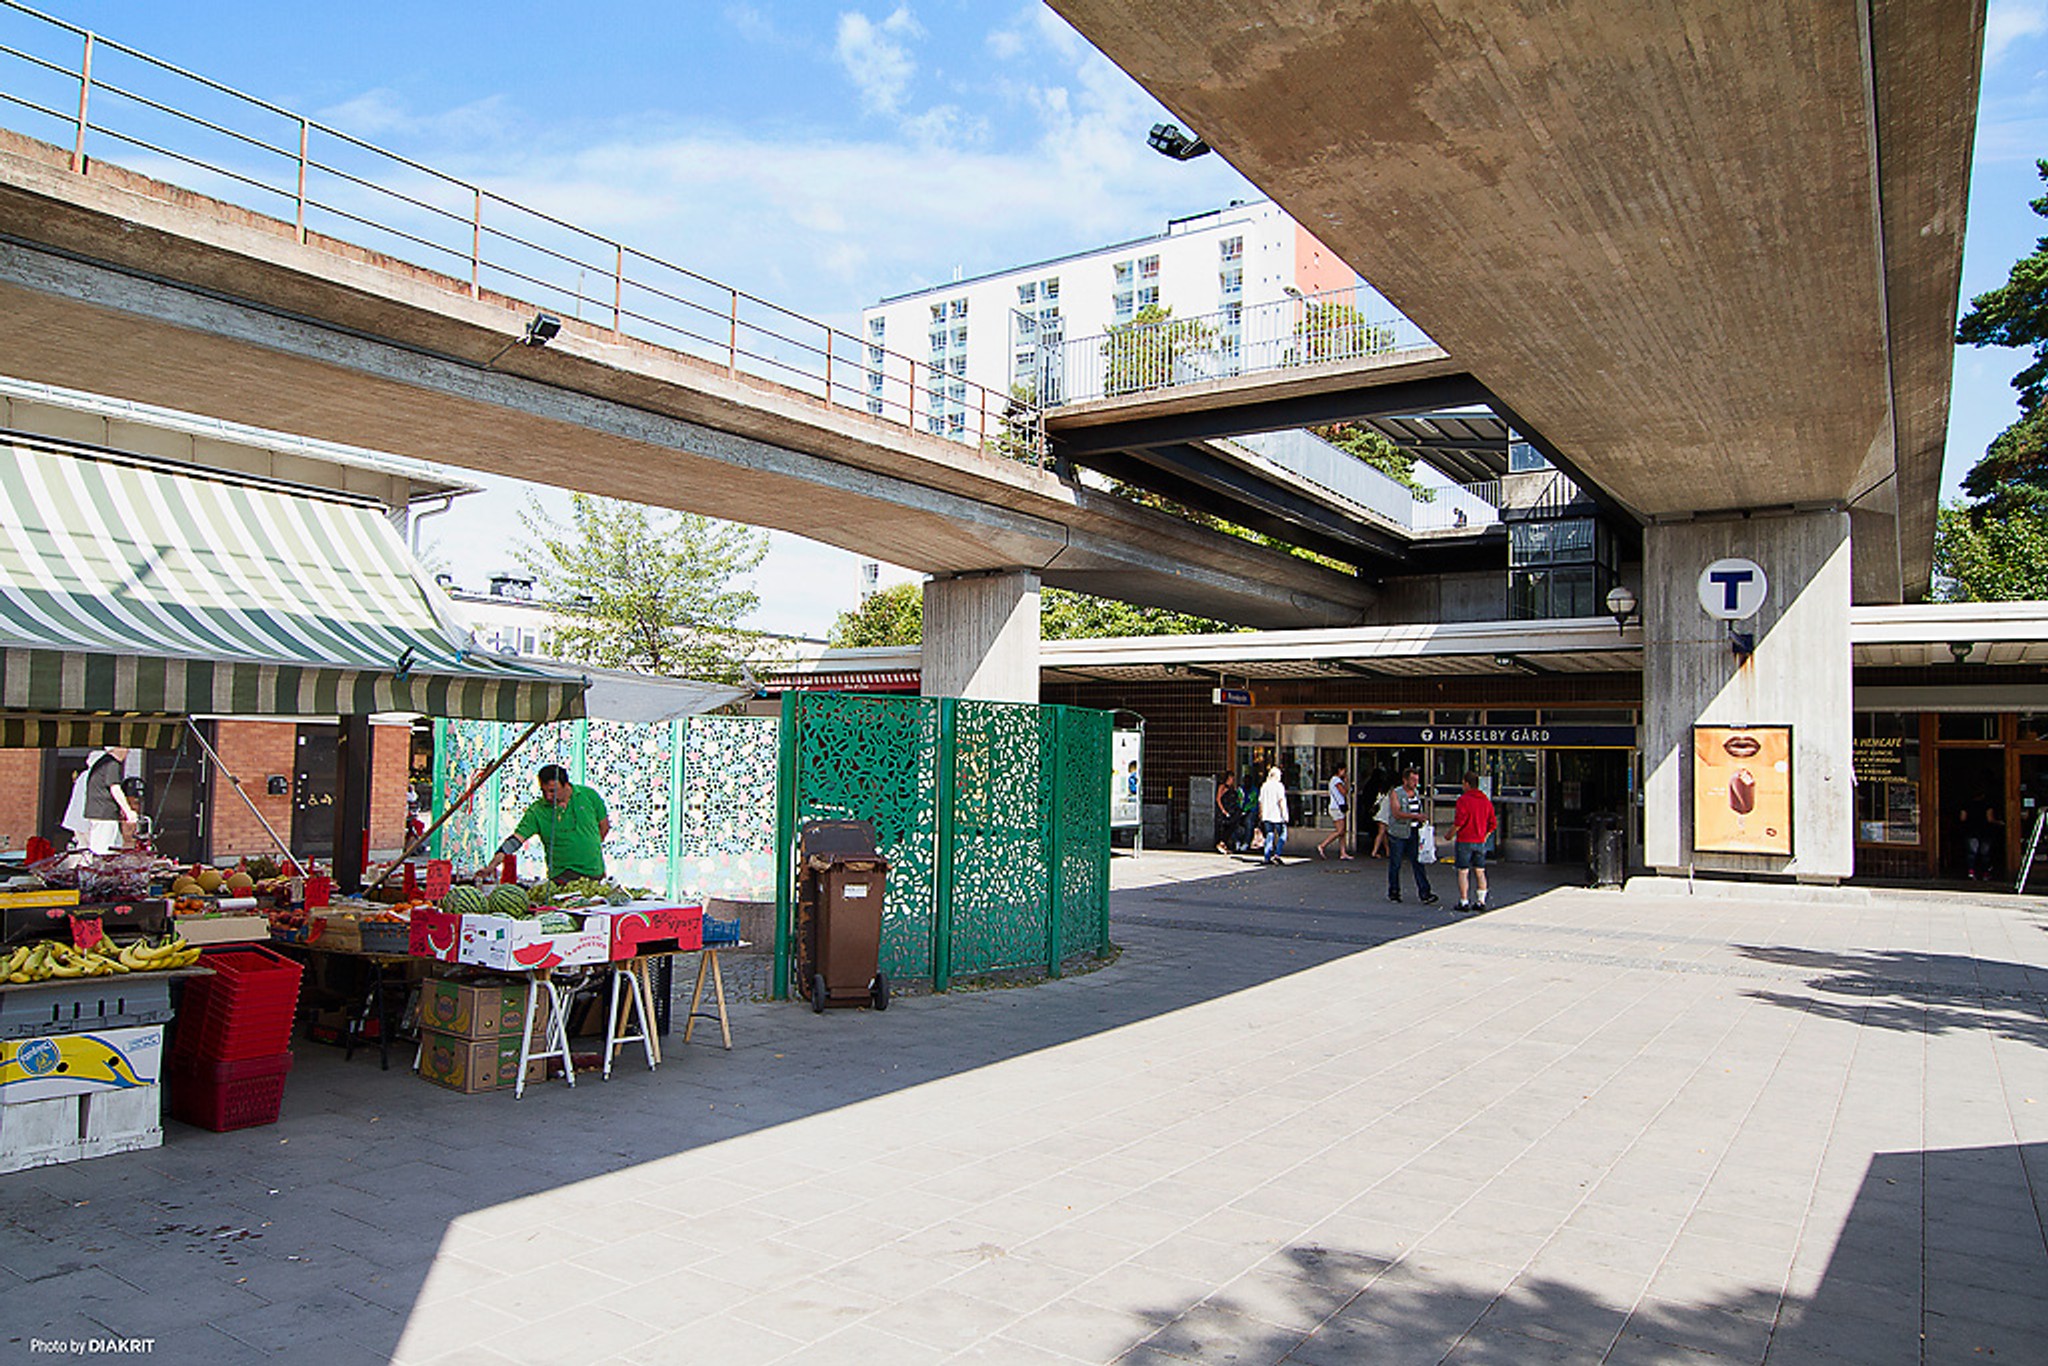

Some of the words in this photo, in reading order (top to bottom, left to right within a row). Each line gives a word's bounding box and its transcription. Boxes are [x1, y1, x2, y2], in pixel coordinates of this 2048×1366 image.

[1710, 570, 1753, 610] T
[1440, 728, 1507, 741] HÄSSELBY
[1511, 728, 1550, 741] GÅRD
